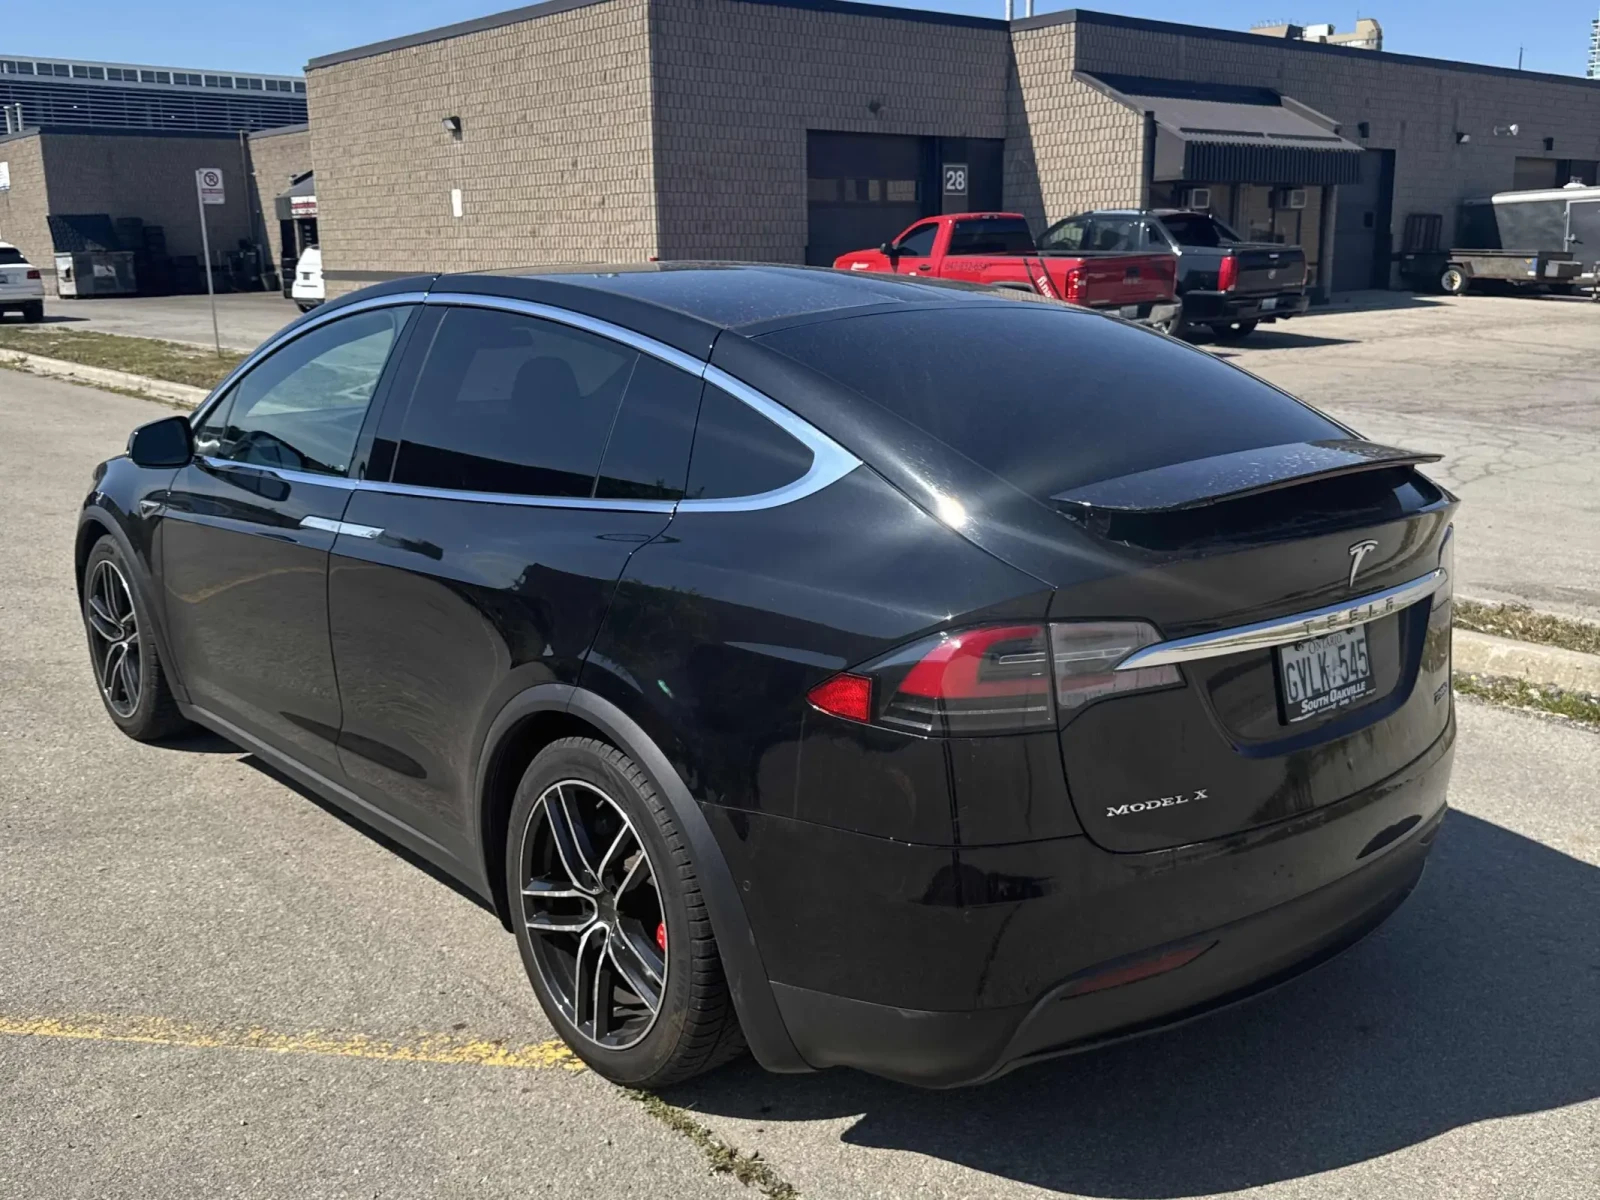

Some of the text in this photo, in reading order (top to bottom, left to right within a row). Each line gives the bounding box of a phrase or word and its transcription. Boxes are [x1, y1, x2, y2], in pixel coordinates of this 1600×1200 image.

[946, 170, 965, 190] 28
[1308, 634, 1342, 654] ONTARIO
[1286, 638, 1369, 701] GVLK 545
[1301, 695, 1330, 714] SOUTH
[1329, 681, 1366, 703] OAKVILLE
[1106, 788, 1208, 817] MODEL X
